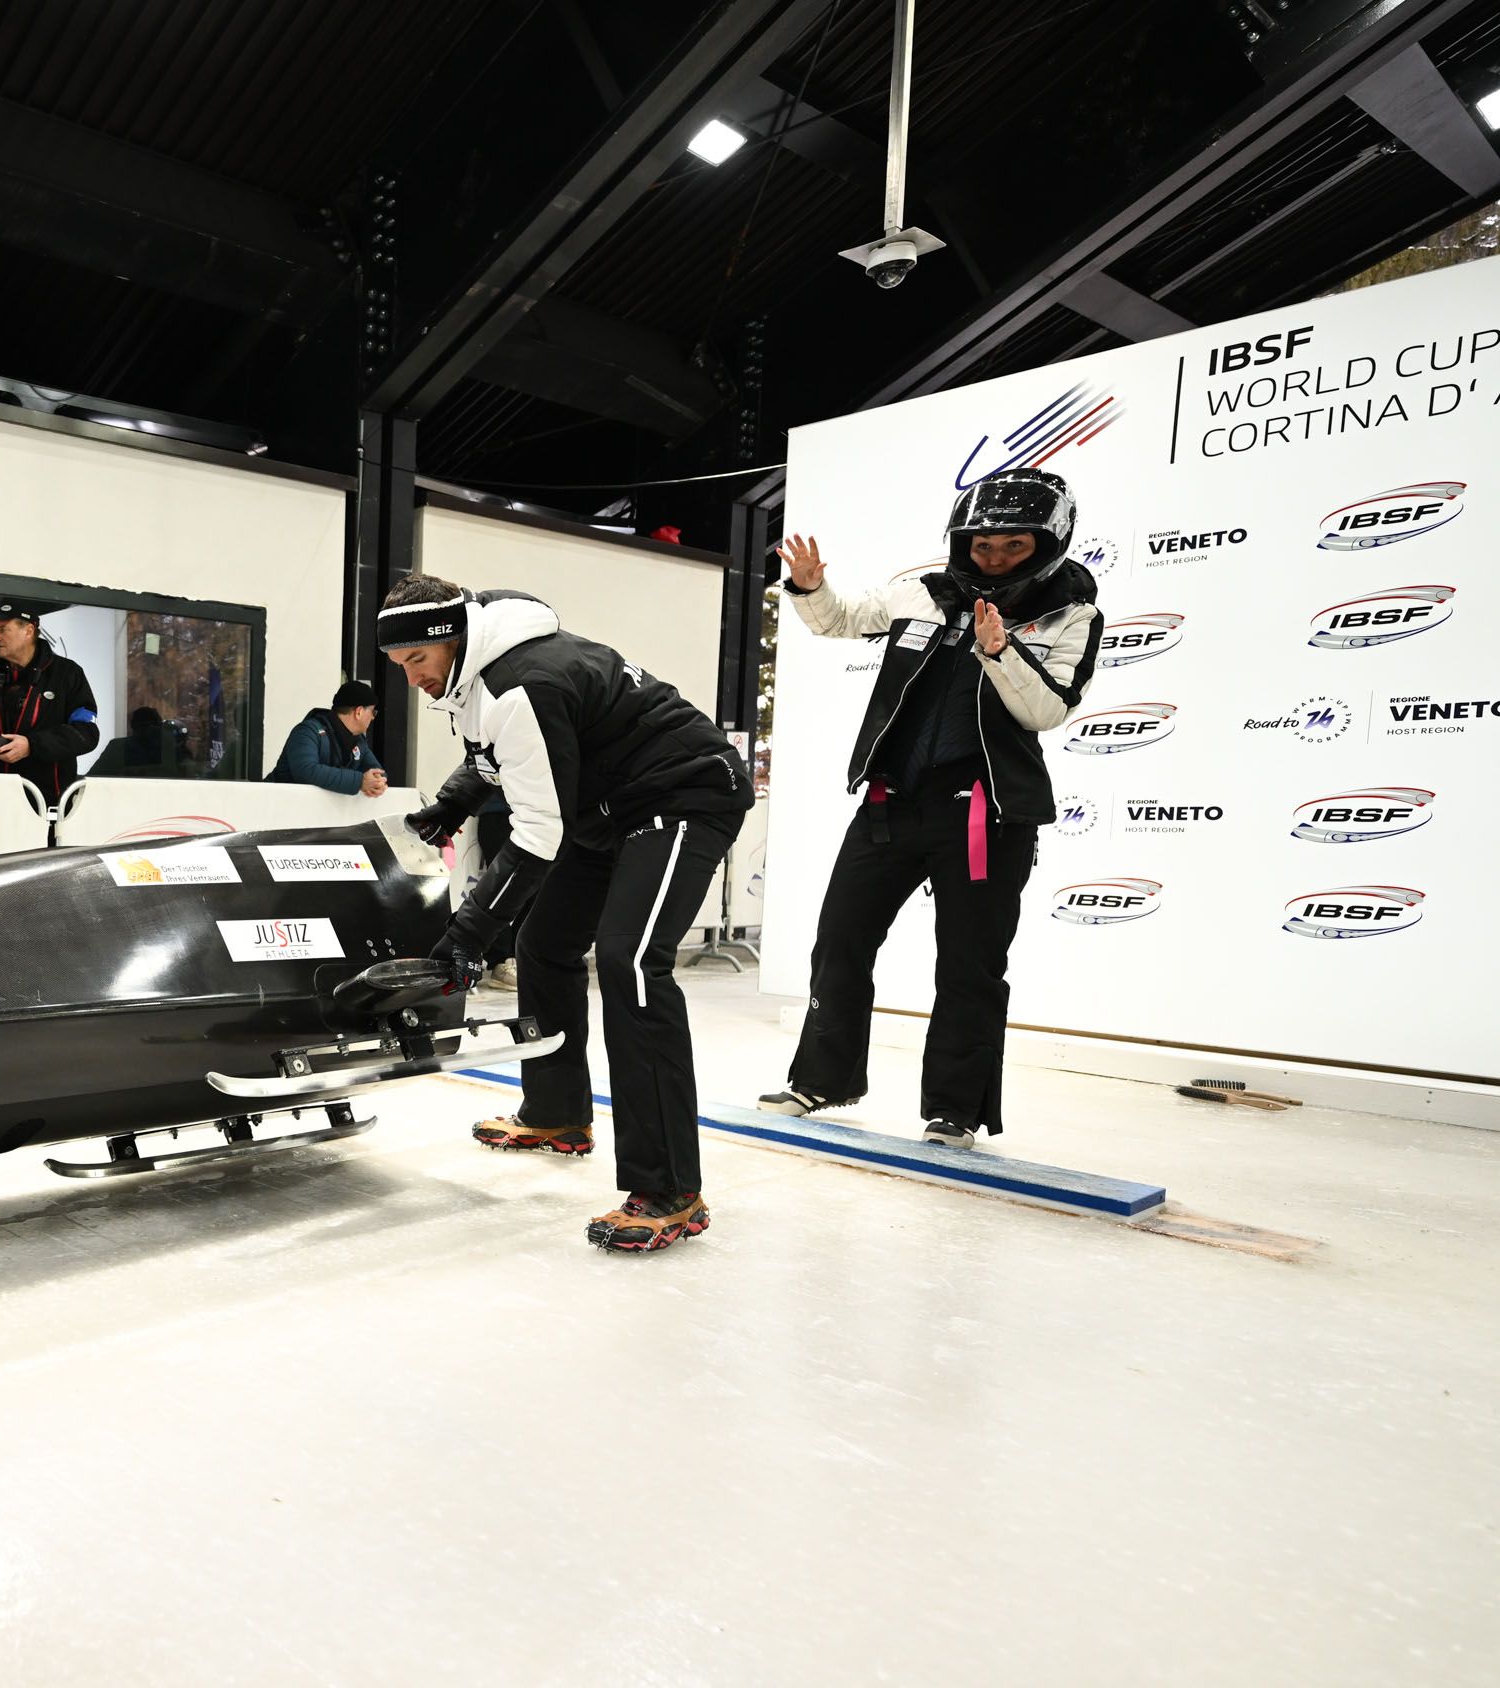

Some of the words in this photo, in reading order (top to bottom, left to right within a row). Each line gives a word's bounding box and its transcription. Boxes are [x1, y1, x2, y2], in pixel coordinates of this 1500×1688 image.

[1208, 325, 1314, 377] IBSF
[1207, 356, 1376, 416] WORLD
[1396, 328, 1500, 378] CUP
[1202, 394, 1409, 457] CORTINA
[1338, 503, 1444, 531] IBSF
[1148, 530, 1181, 539] REGIONE
[1148, 528, 1247, 555] VENETO
[1146, 560, 1169, 568] HOST
[1173, 554, 1208, 564] REGION
[1329, 606, 1433, 629] IBSF
[427, 623, 453, 636] SEIZ
[1101, 632, 1167, 649] BSF
[846, 662, 870, 672] Road
[1389, 695, 1431, 704] REGIONE
[1079, 721, 1160, 738] IBSF
[1243, 717, 1283, 730] Road
[1283, 717, 1300, 729] to
[1386, 728, 1417, 736] HOST
[1420, 726, 1465, 735] REGION
[1127, 806, 1223, 821] VENETO
[1311, 807, 1414, 824] IBSF
[1067, 893, 1146, 910] IBSF
[1302, 903, 1404, 922] IBSF
